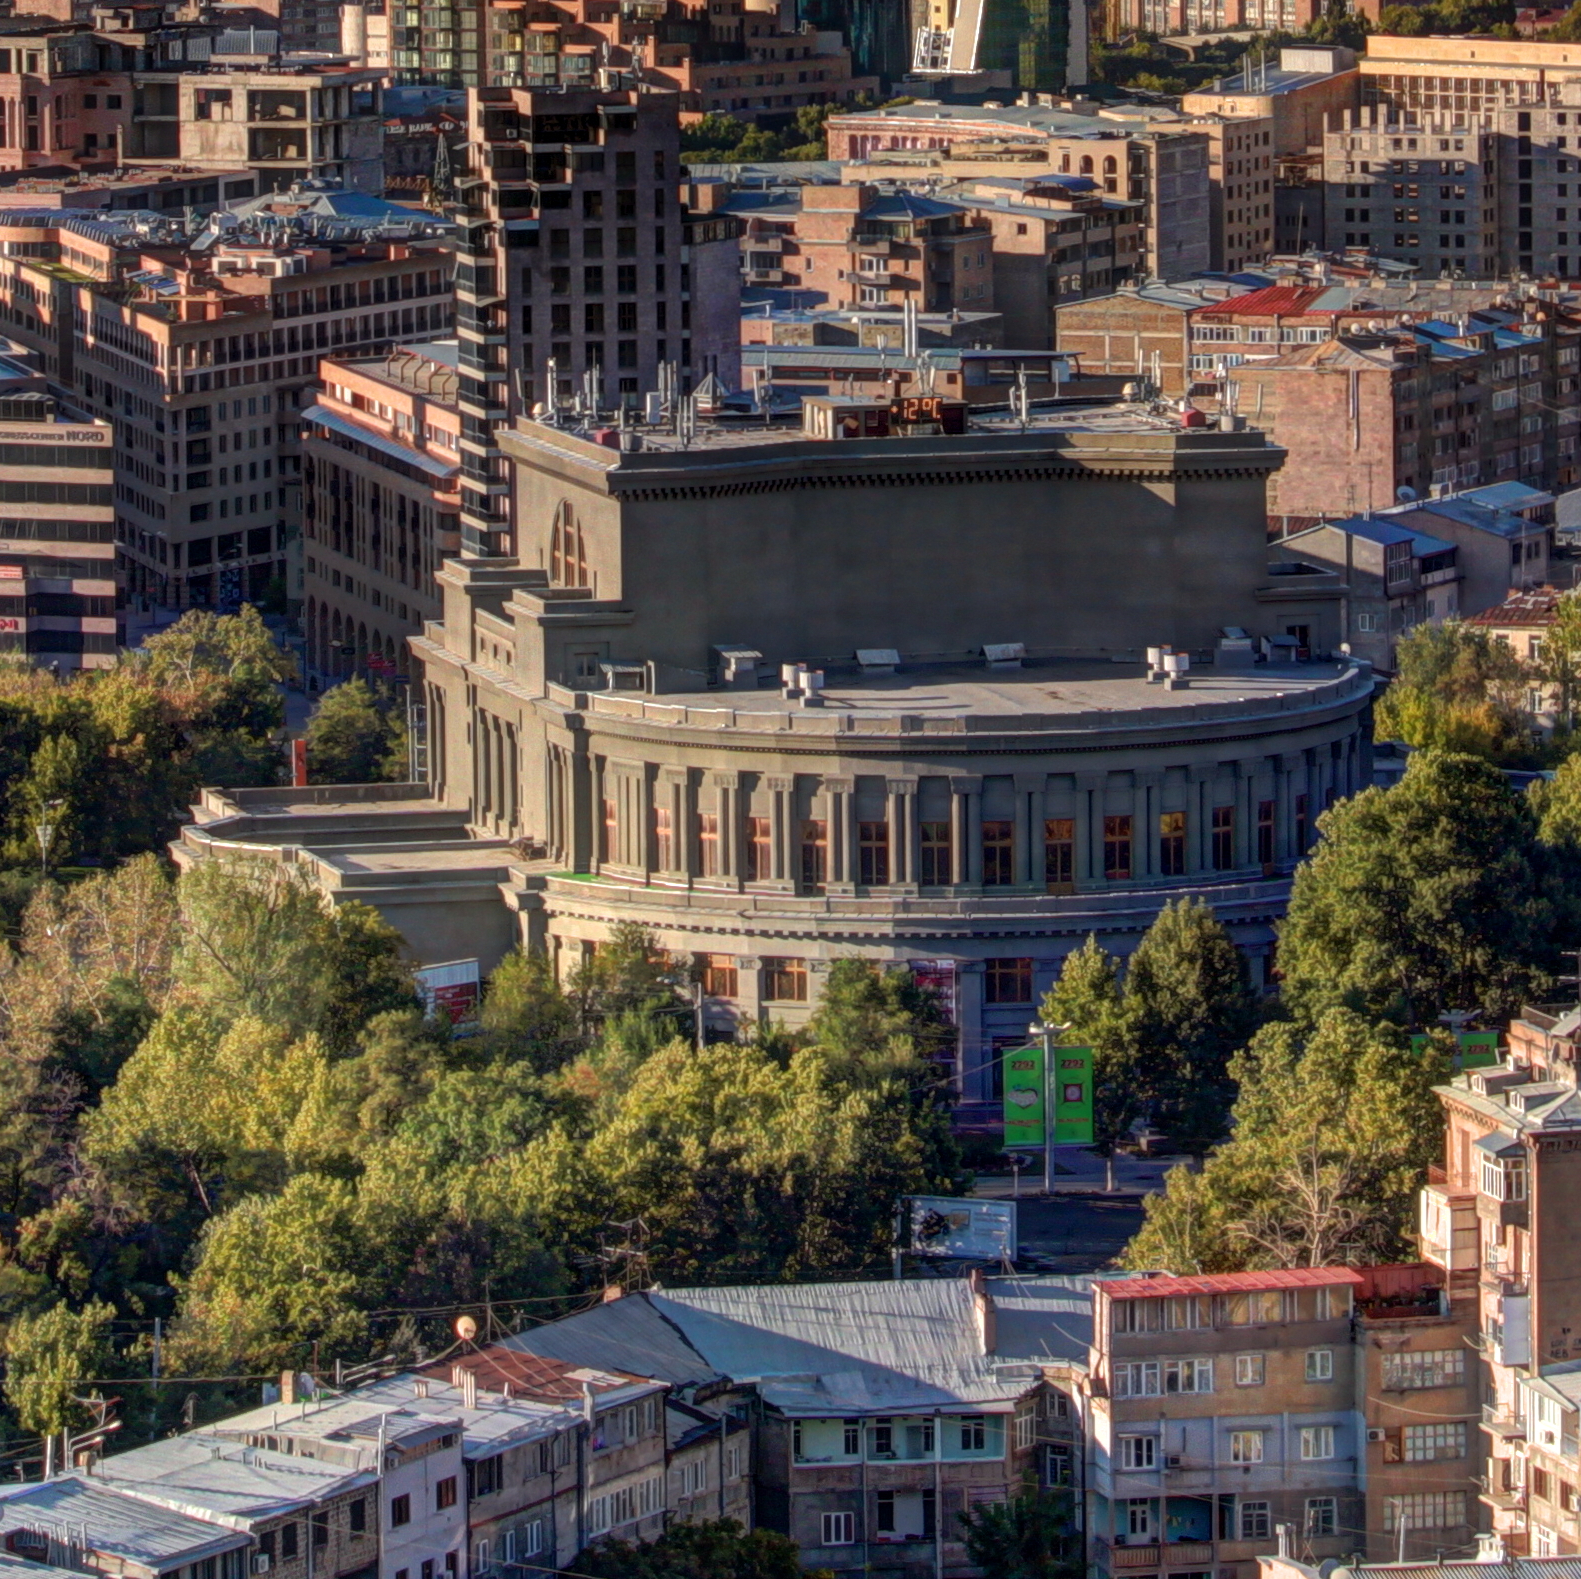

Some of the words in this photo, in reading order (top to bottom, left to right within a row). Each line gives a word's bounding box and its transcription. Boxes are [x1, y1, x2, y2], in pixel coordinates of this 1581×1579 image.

[65, 430, 105, 442] NORD
[1468, 1044, 1490, 1055] 2792
[1011, 1060, 1035, 1071] 2792
[1061, 1059, 1085, 1069] 2792
